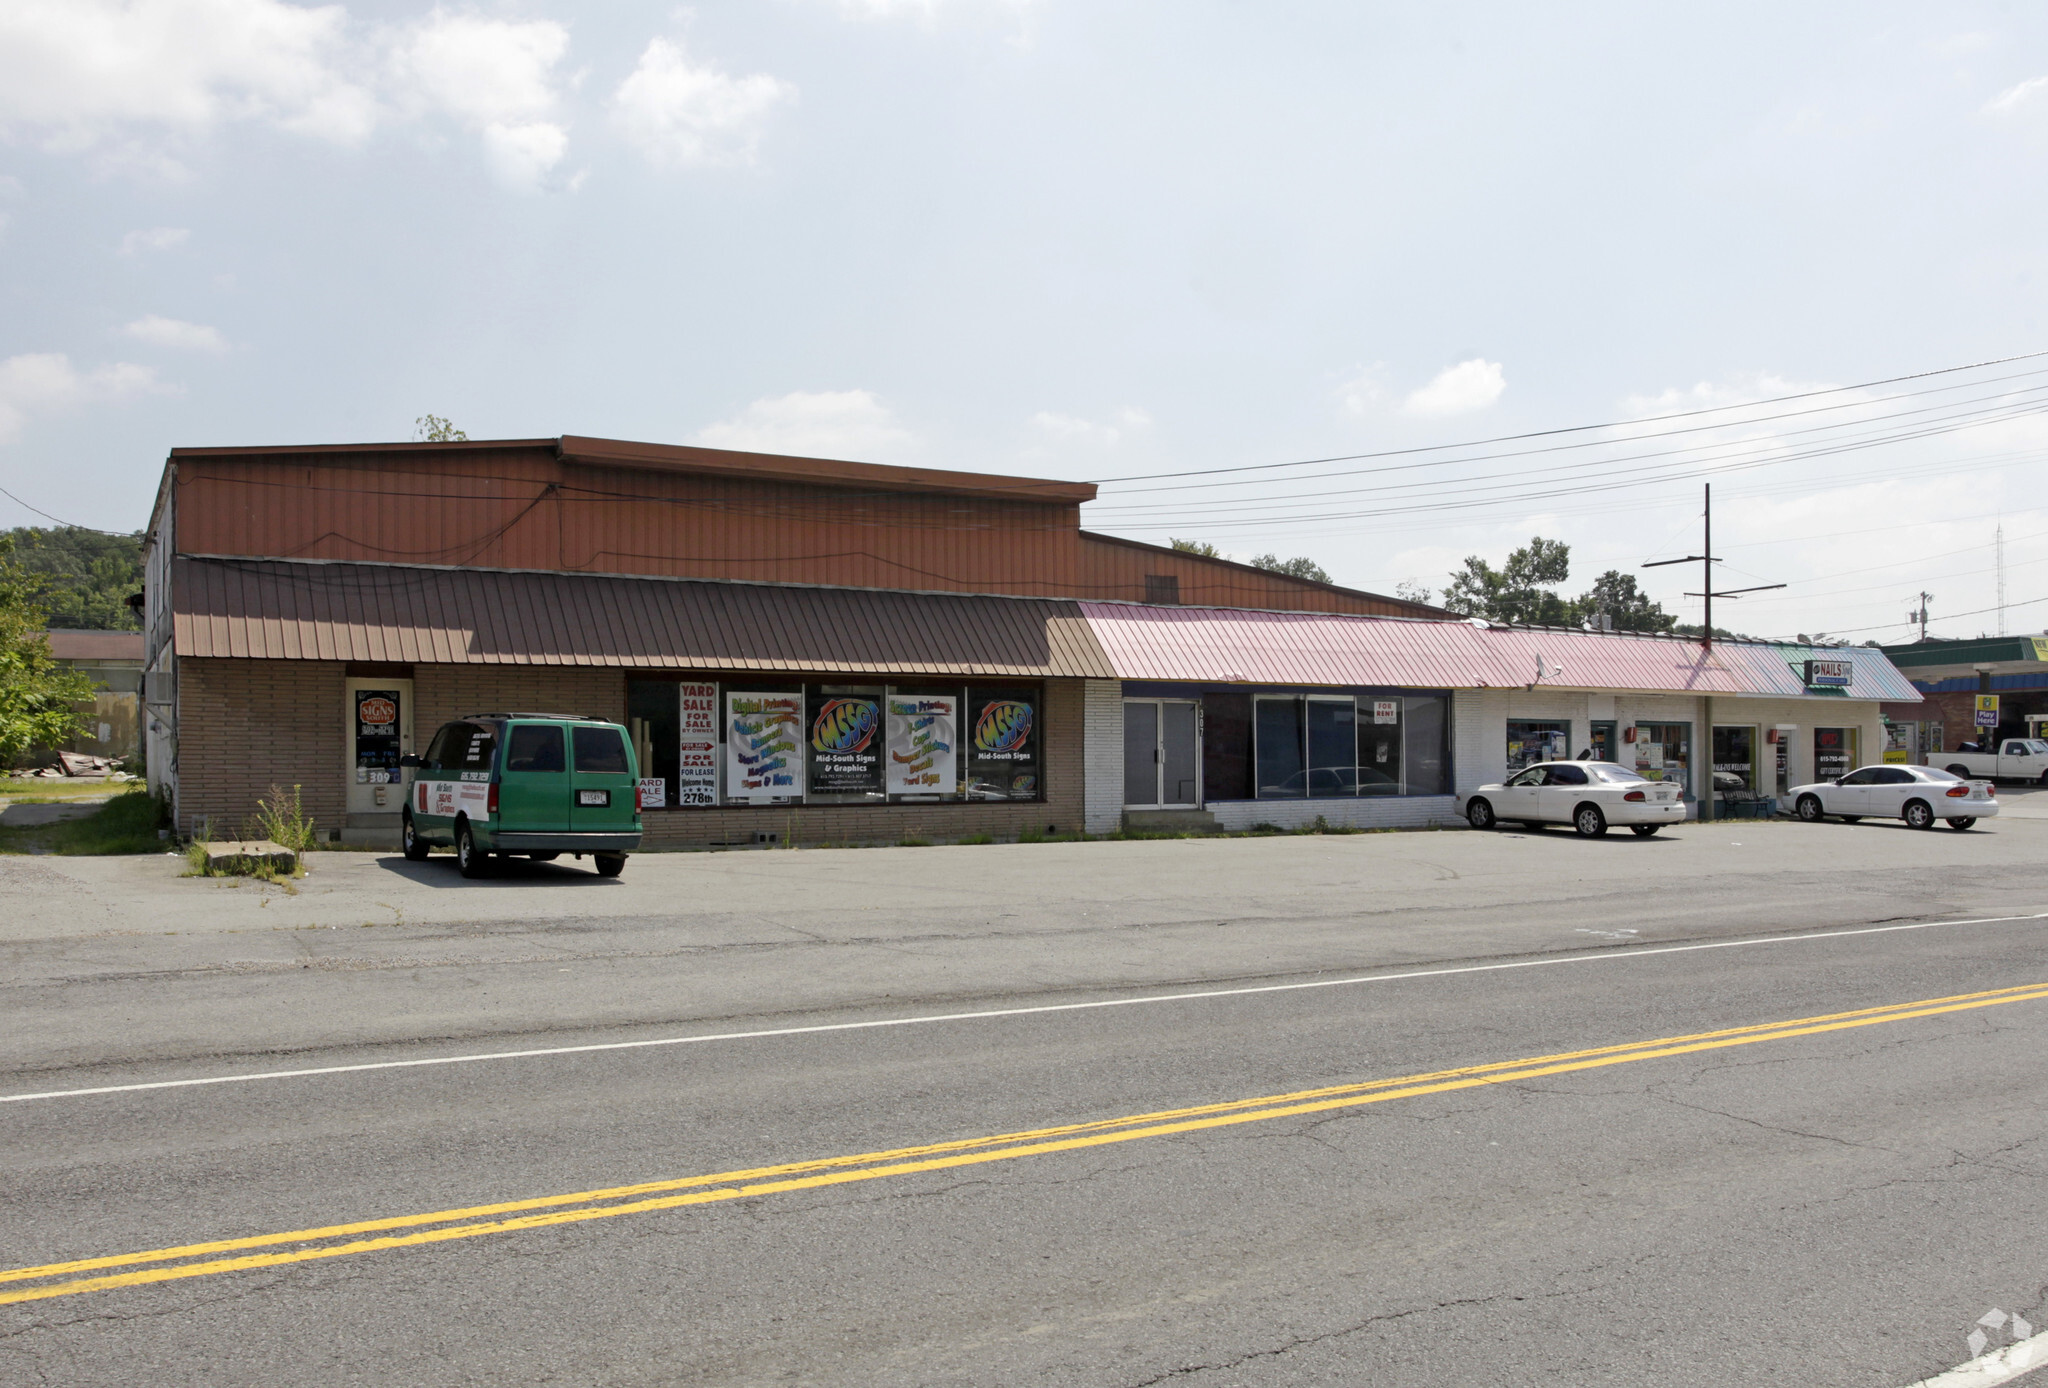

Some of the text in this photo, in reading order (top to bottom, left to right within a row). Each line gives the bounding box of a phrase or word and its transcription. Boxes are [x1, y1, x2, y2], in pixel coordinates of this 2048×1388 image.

[1821, 663, 1842, 676] NAILS
[682, 685, 715, 697] YARD
[362, 705, 394, 716] SIGNS
[683, 700, 713, 711] SALE
[732, 698, 762, 717] Digital
[889, 700, 917, 714] Screen
[1979, 711, 1994, 719] Play
[734, 714, 799, 735] Vehicle Graphics
[820, 703, 872, 749] MSSG
[907, 716, 935, 735] T-Shirts
[982, 705, 1027, 747] MSSG
[751, 728, 783, 750] Banners
[913, 731, 931, 747] Caps
[738, 742, 796, 765] Store Windows
[856, 754, 876, 764] Signs
[893, 740, 950, 765] Bumper Stickers
[1013, 752, 1031, 761] Signs
[748, 757, 787, 777] Magnetics
[824, 764, 867, 773] & Graphics
[909, 757, 934, 774] Decals
[1731, 763, 1751, 771] WELCOME
[370, 772, 390, 783] 309
[682, 778, 714, 788] Welcome Home
[741, 773, 793, 789] Signs & More
[903, 772, 941, 787] Yard Signs
[439, 794, 453, 803] SIGNS
[683, 793, 713, 804] 278th
